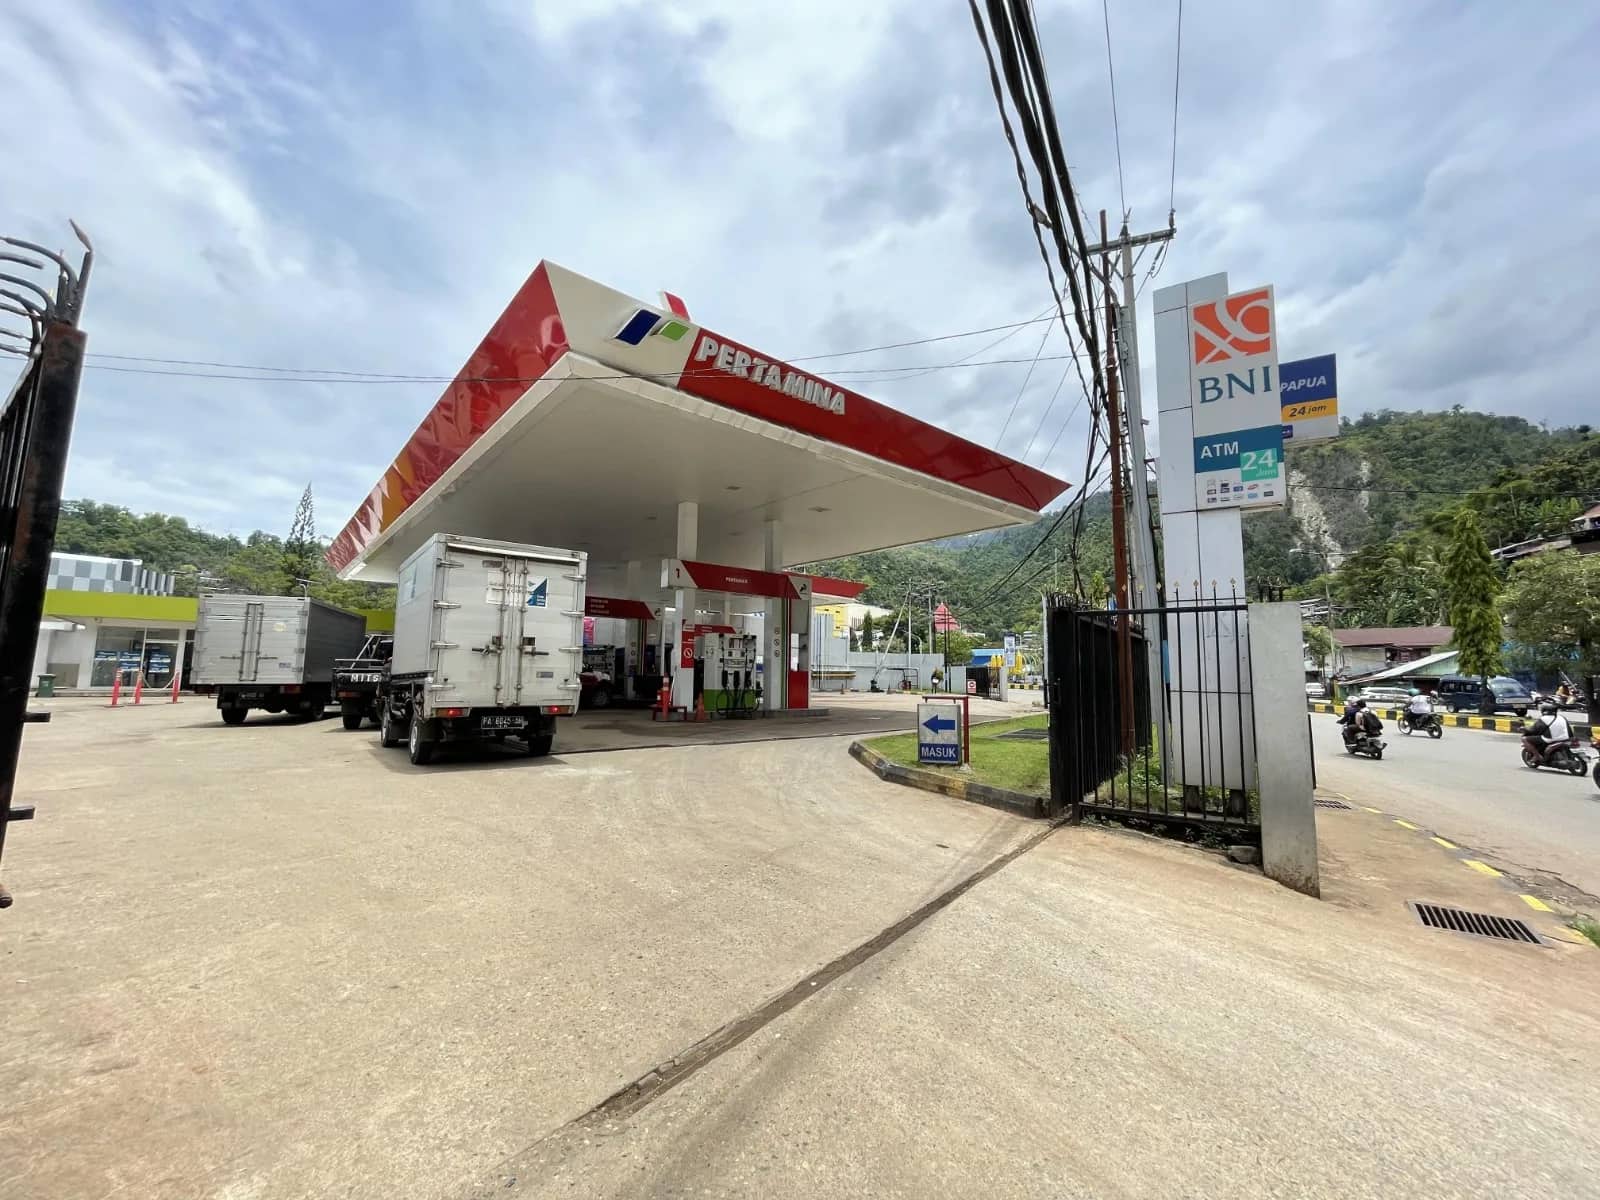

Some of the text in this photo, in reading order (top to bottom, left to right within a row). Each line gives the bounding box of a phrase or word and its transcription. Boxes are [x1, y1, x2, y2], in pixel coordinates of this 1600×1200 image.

[694, 336, 846, 415] PERTAMINA
[1198, 366, 1272, 403] BNI
[1280, 376, 1327, 392] PAPUA
[1288, 406, 1305, 417] 24
[1200, 441, 1239, 459] ATM
[1242, 449, 1276, 470] 24
[921, 746, 956, 758] MASUK
